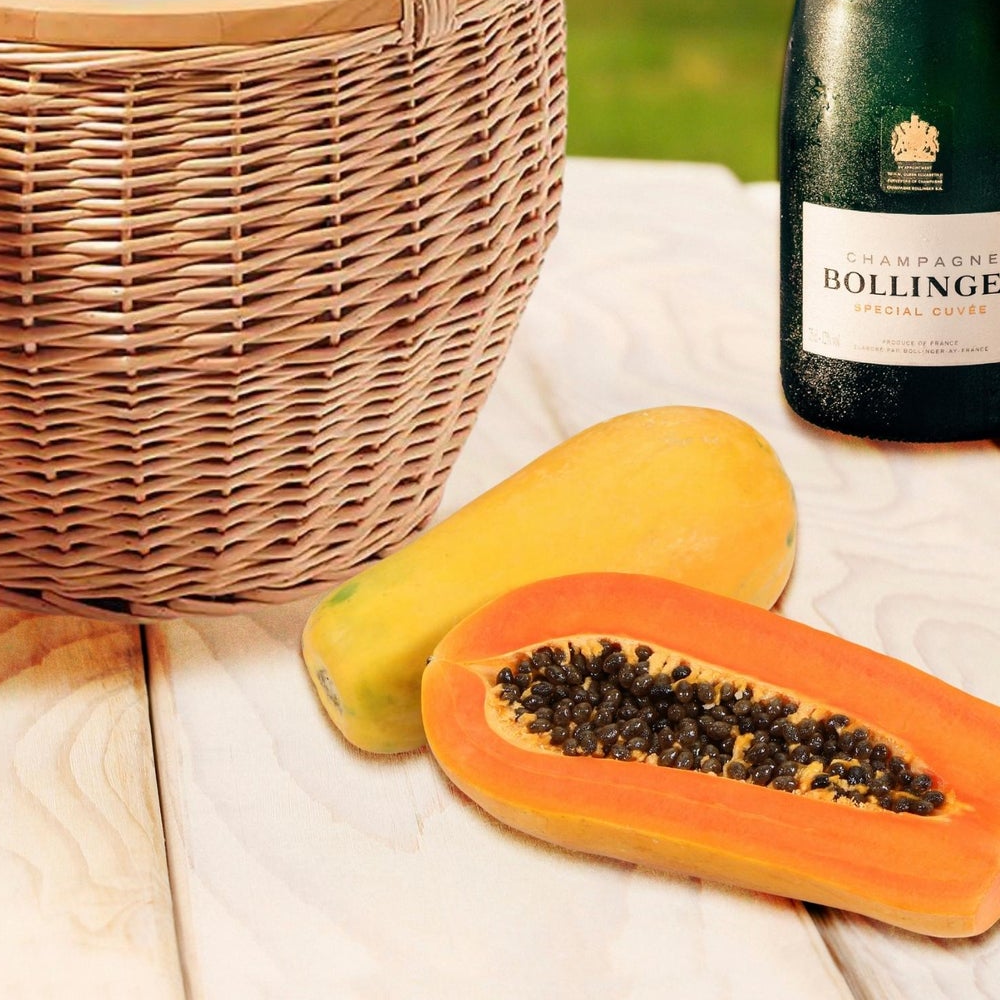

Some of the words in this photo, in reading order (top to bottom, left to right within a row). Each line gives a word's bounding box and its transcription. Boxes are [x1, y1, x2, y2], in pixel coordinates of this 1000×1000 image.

[846, 252, 998, 267] CHAMPAGNE
[854, 304, 924, 316] SPECIAL
[932, 303, 988, 317] CUVÉE
